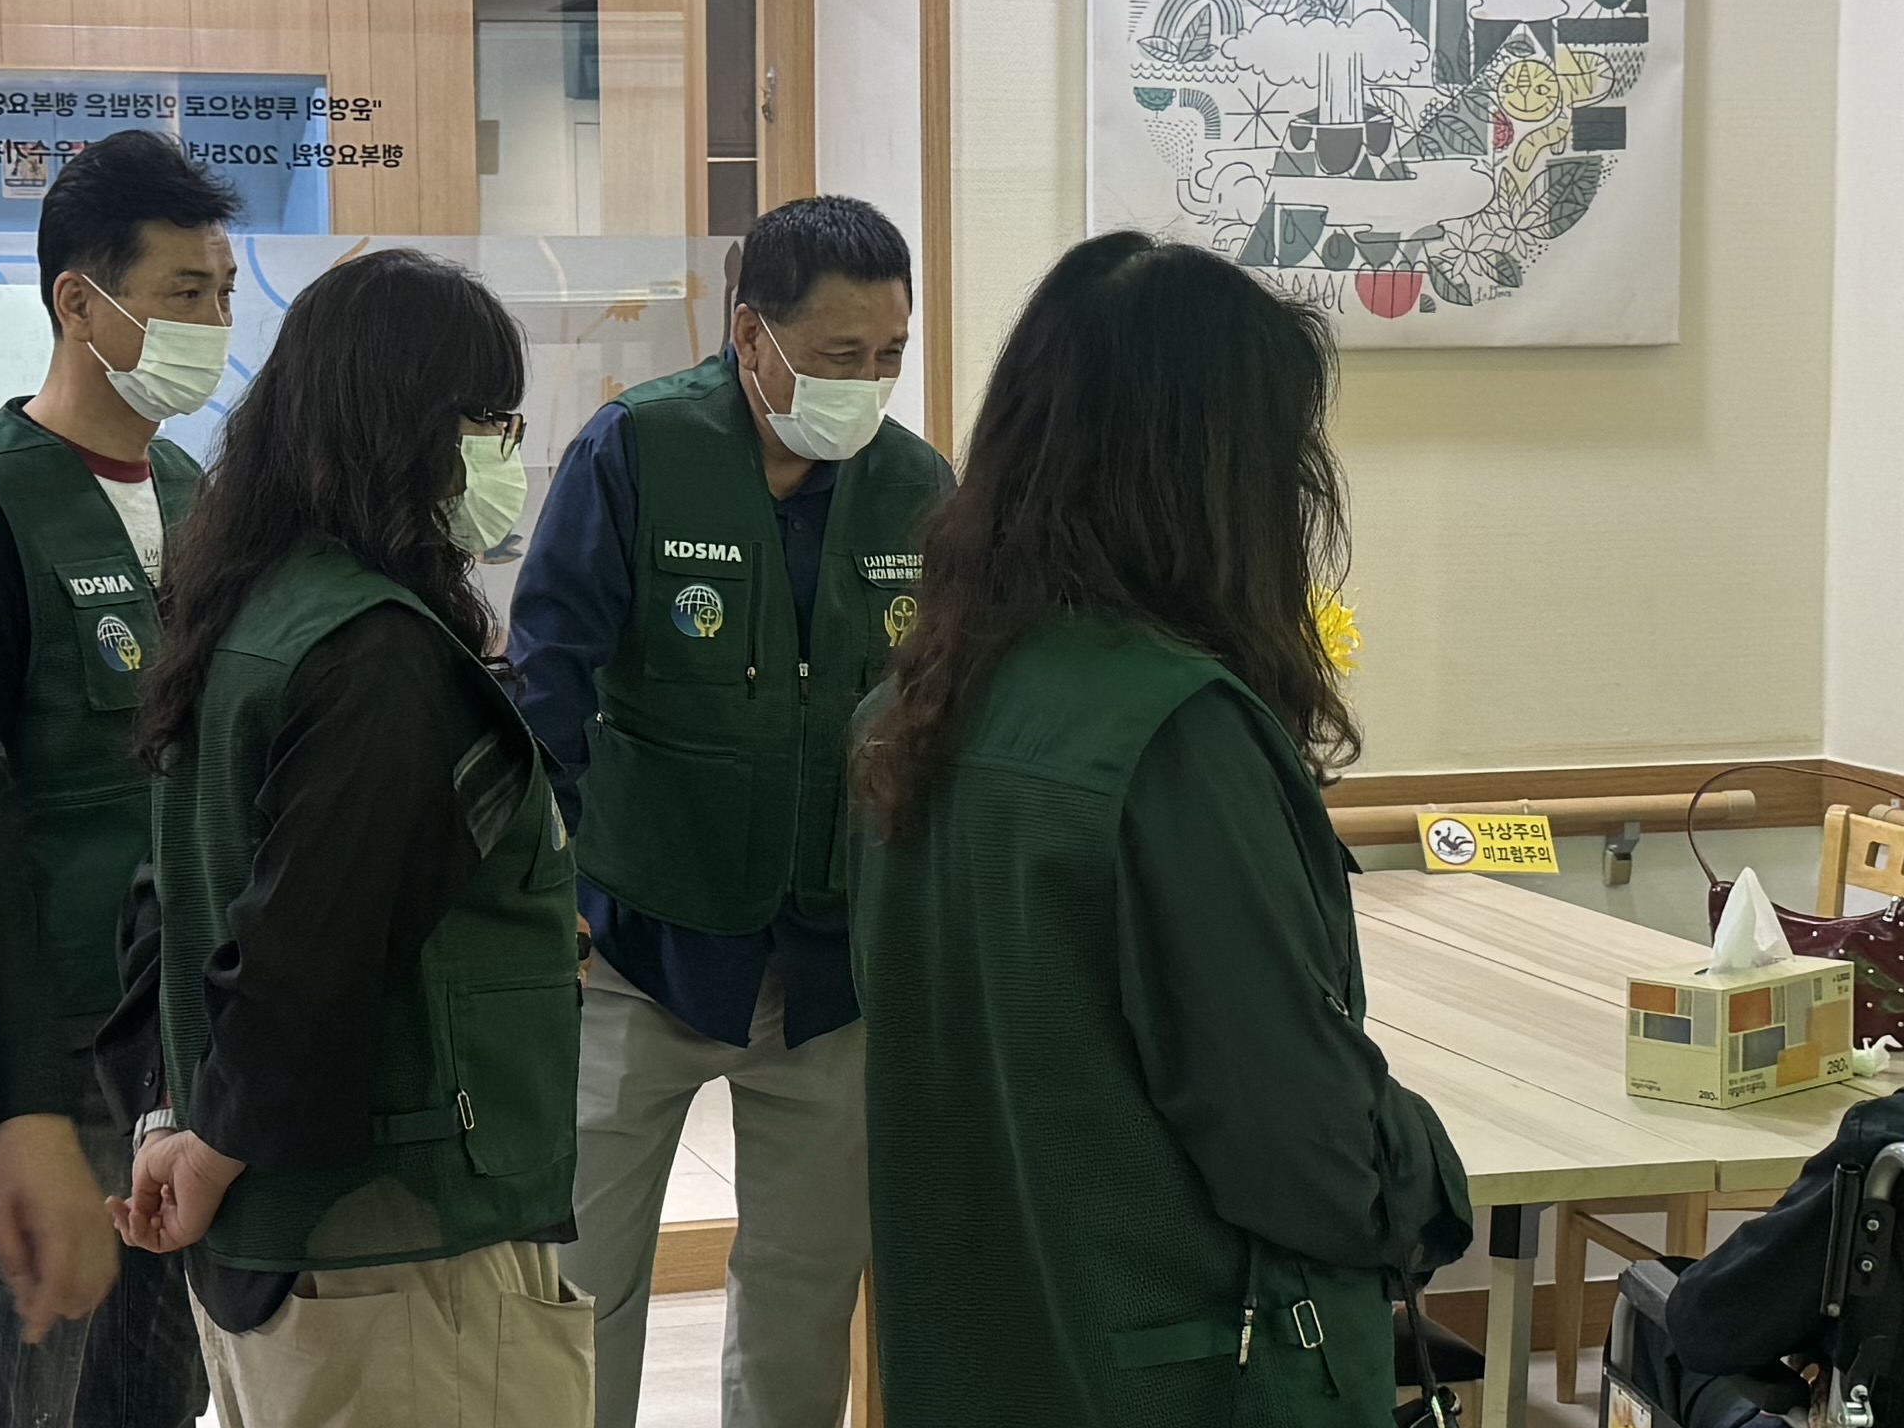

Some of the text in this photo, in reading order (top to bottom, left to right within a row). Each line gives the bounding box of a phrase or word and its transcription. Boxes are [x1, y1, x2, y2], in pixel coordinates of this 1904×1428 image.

[664, 539, 742, 563] KDSMA
[69, 575, 135, 596] KDSMA
[1478, 822, 1547, 841] 낙상주의
[1483, 845, 1552, 864] 미끄럼주의
